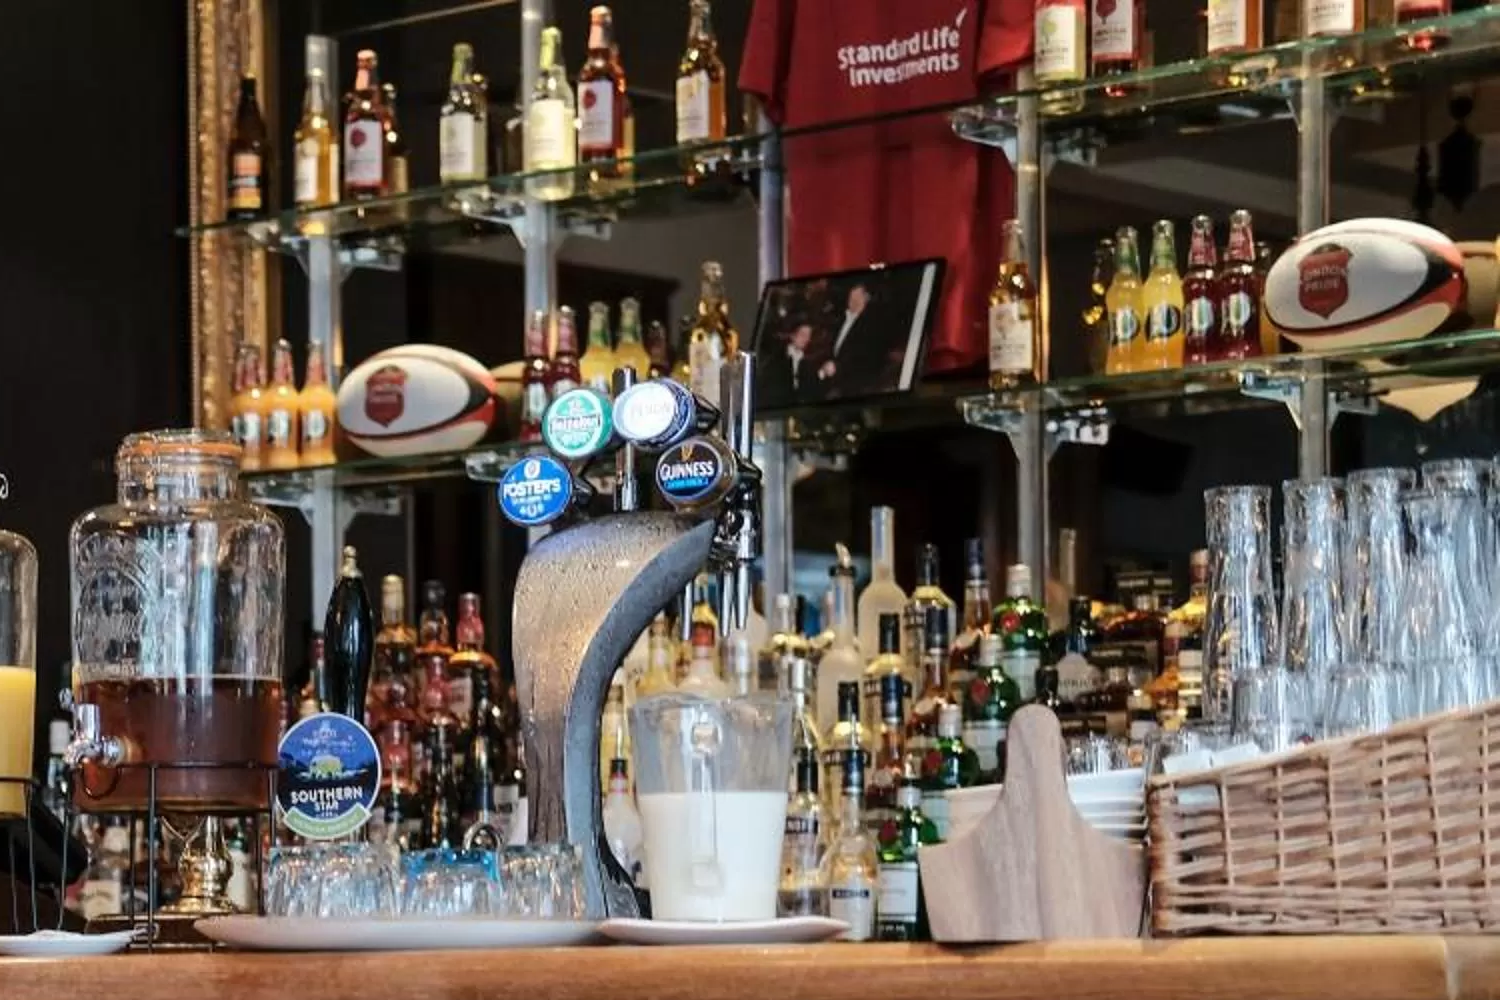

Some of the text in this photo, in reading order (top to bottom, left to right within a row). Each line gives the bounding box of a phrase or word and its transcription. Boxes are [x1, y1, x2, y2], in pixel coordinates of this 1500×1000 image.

[922, 26, 960, 51] Life
[660, 460, 715, 481] GUINNESS
[503, 478, 561, 500] FOSTER'S
[290, 786, 364, 805] SOUTHERN
[314, 801, 339, 812] STAR
